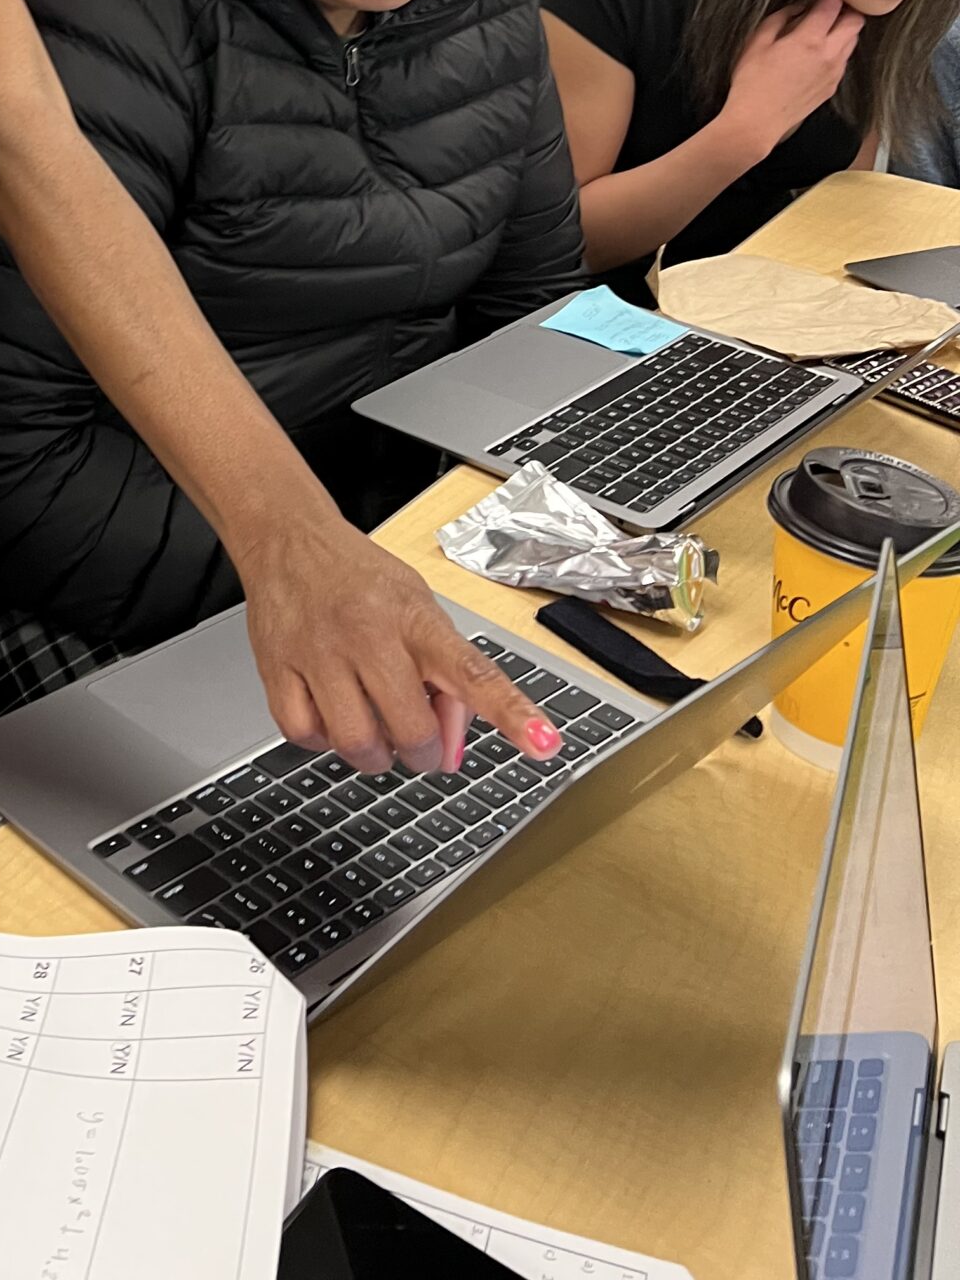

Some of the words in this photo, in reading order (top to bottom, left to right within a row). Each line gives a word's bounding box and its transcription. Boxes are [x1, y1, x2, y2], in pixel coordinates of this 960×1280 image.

[32, 961, 51, 980] 28
[127, 956, 145, 976] 27
[19, 995, 42, 1022] Y/N
[119, 994, 140, 1027] Y/N
[242, 989, 262, 1020] Y/N
[6, 1035, 30, 1061] Y/N
[109, 1043, 132, 1074] Y/N
[236, 1037, 257, 1072] Y/N
